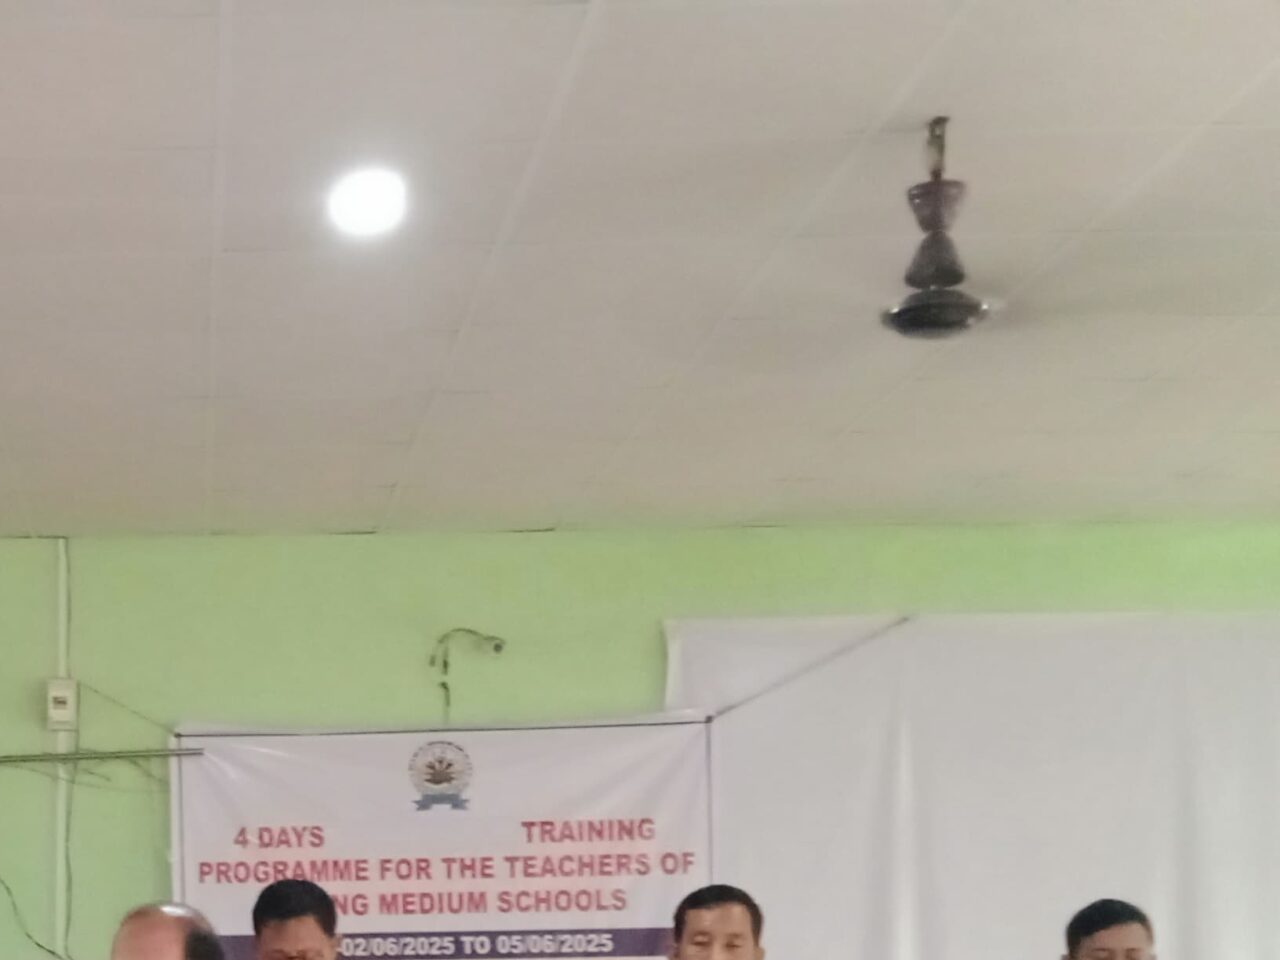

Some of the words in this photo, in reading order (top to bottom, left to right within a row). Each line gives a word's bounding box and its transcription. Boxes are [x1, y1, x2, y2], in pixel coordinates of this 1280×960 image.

[234, 827, 249, 848] 4
[259, 826, 325, 849] DAYS
[521, 818, 656, 843] TRAINING
[198, 859, 369, 884] PROGRAMME
[379, 858, 432, 881] FOR
[441, 856, 495, 879] THE
[503, 853, 651, 879] TEACHERS
[660, 852, 696, 875] OF
[331, 893, 369, 915] NG
[379, 891, 488, 915] MEDIUM
[497, 889, 627, 913] SCHOOLS
[460, 936, 491, 955] TO
[495, 933, 614, 954] 05/06/2025
